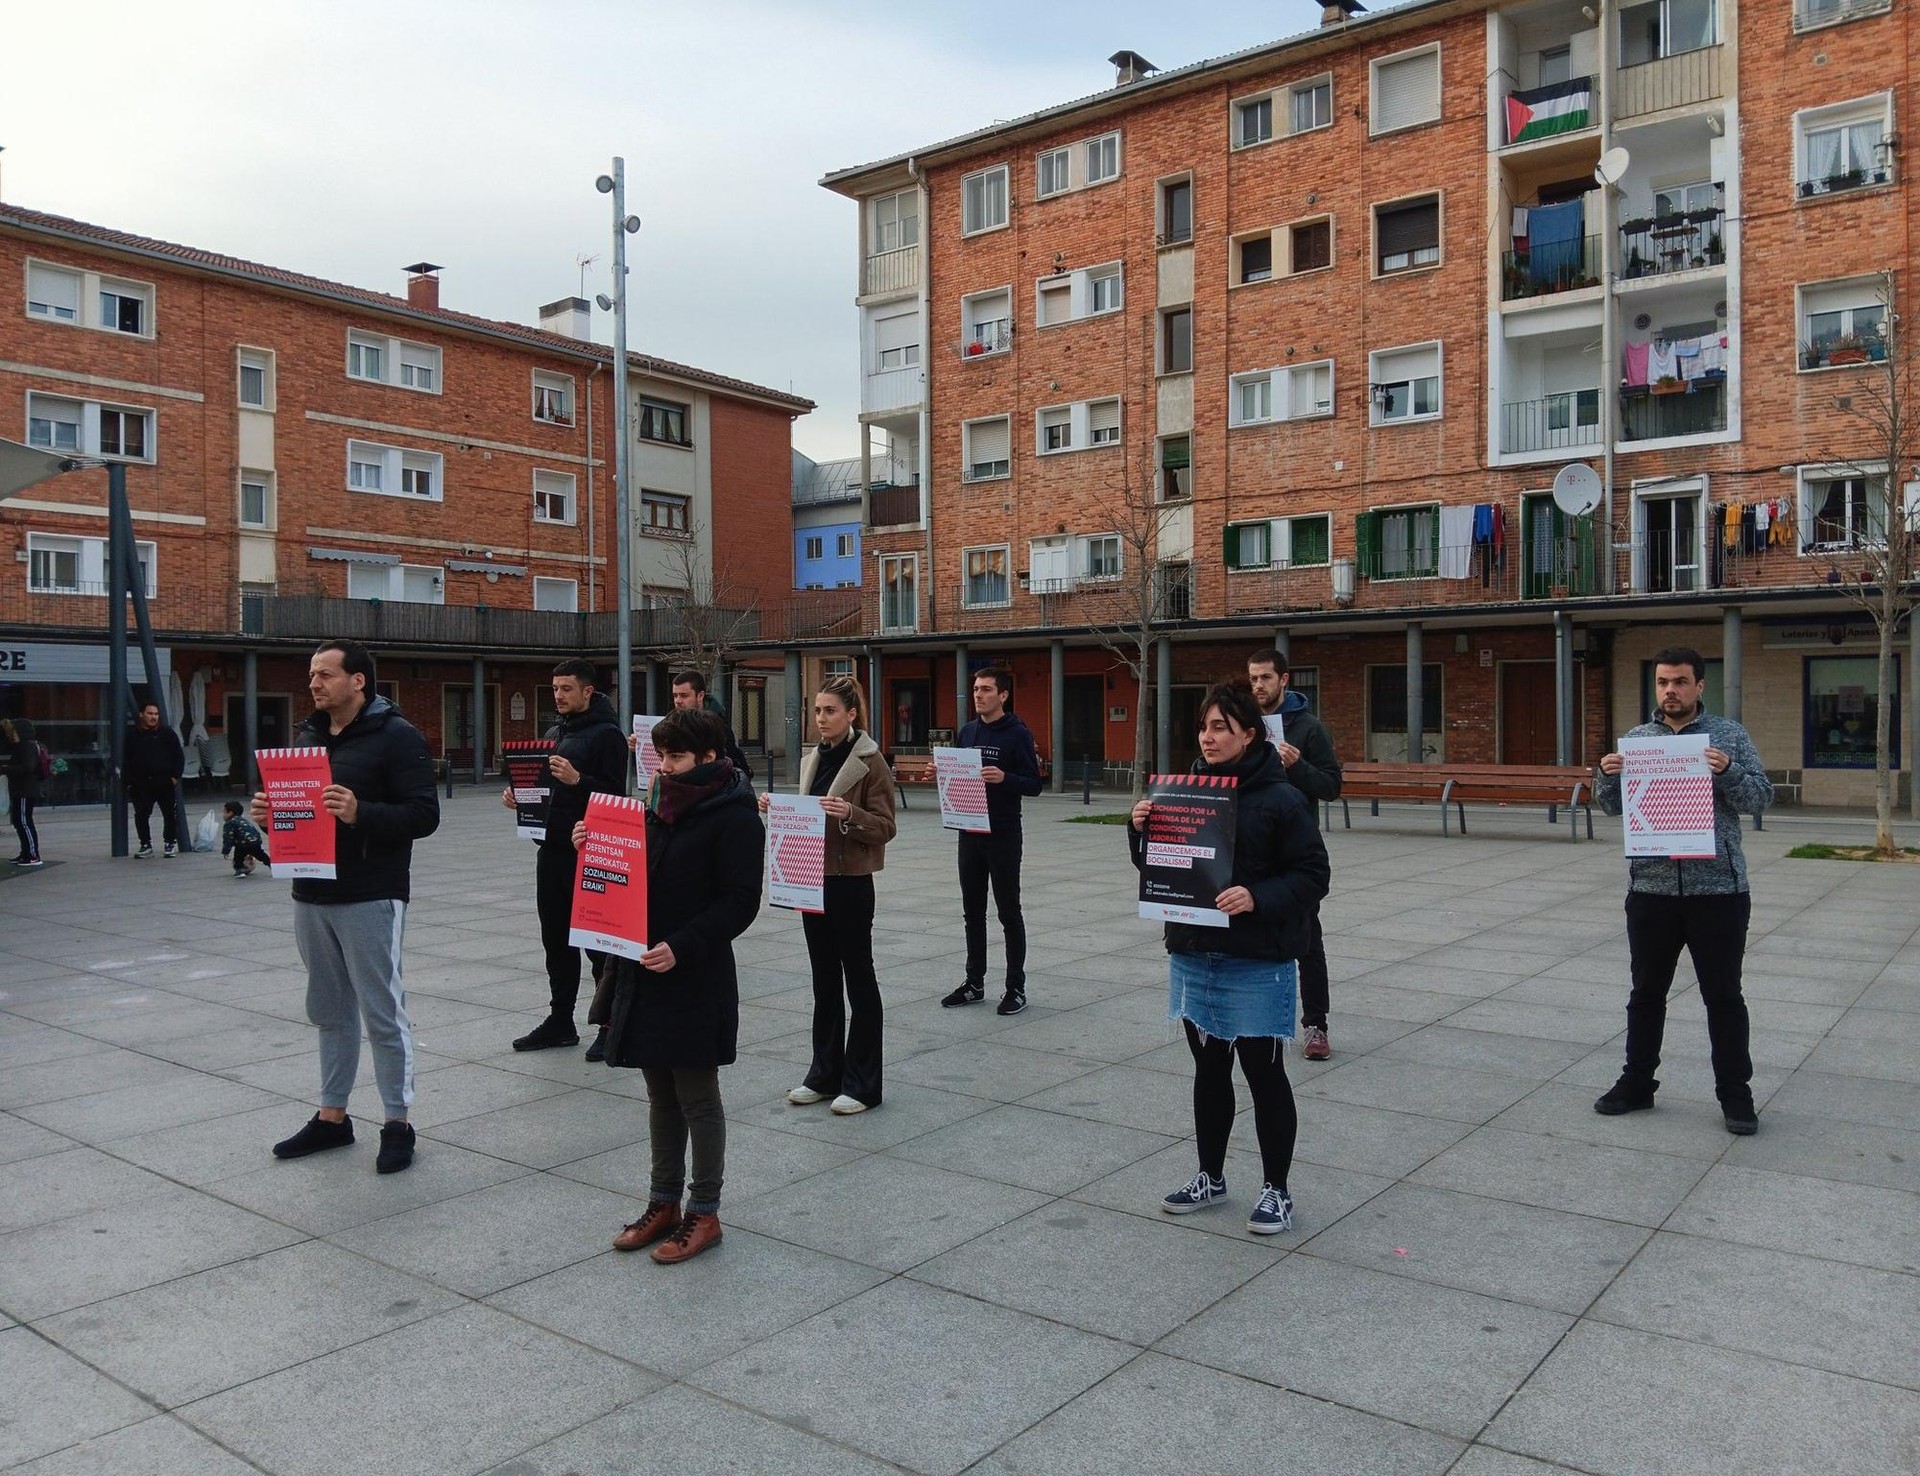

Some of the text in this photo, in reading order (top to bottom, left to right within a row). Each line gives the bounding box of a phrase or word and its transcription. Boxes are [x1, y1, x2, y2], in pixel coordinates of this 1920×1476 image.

[1625, 748, 1664, 757] NAGUSIEN
[1625, 757, 1699, 766] INPUNITATEAREKIN
[1190, 807, 1206, 815] POR
[1206, 808, 1217, 816] LA
[1150, 814, 1205, 825] DEFENSA DE LAS
[1149, 824, 1197, 834] CONDICIONES
[586, 830, 641, 849] LAN BALDINTZEN
[585, 842, 624, 858] DEFENTSAN
[1148, 844, 1213, 857] ORGANICEMOS EL
[584, 853, 631, 873] BORROKATUZ,
[1147, 855, 1191, 867] SOCIALISMO
[583, 867, 627, 884] SOZIALISMOA
[582, 880, 605, 892] ERAIKI
